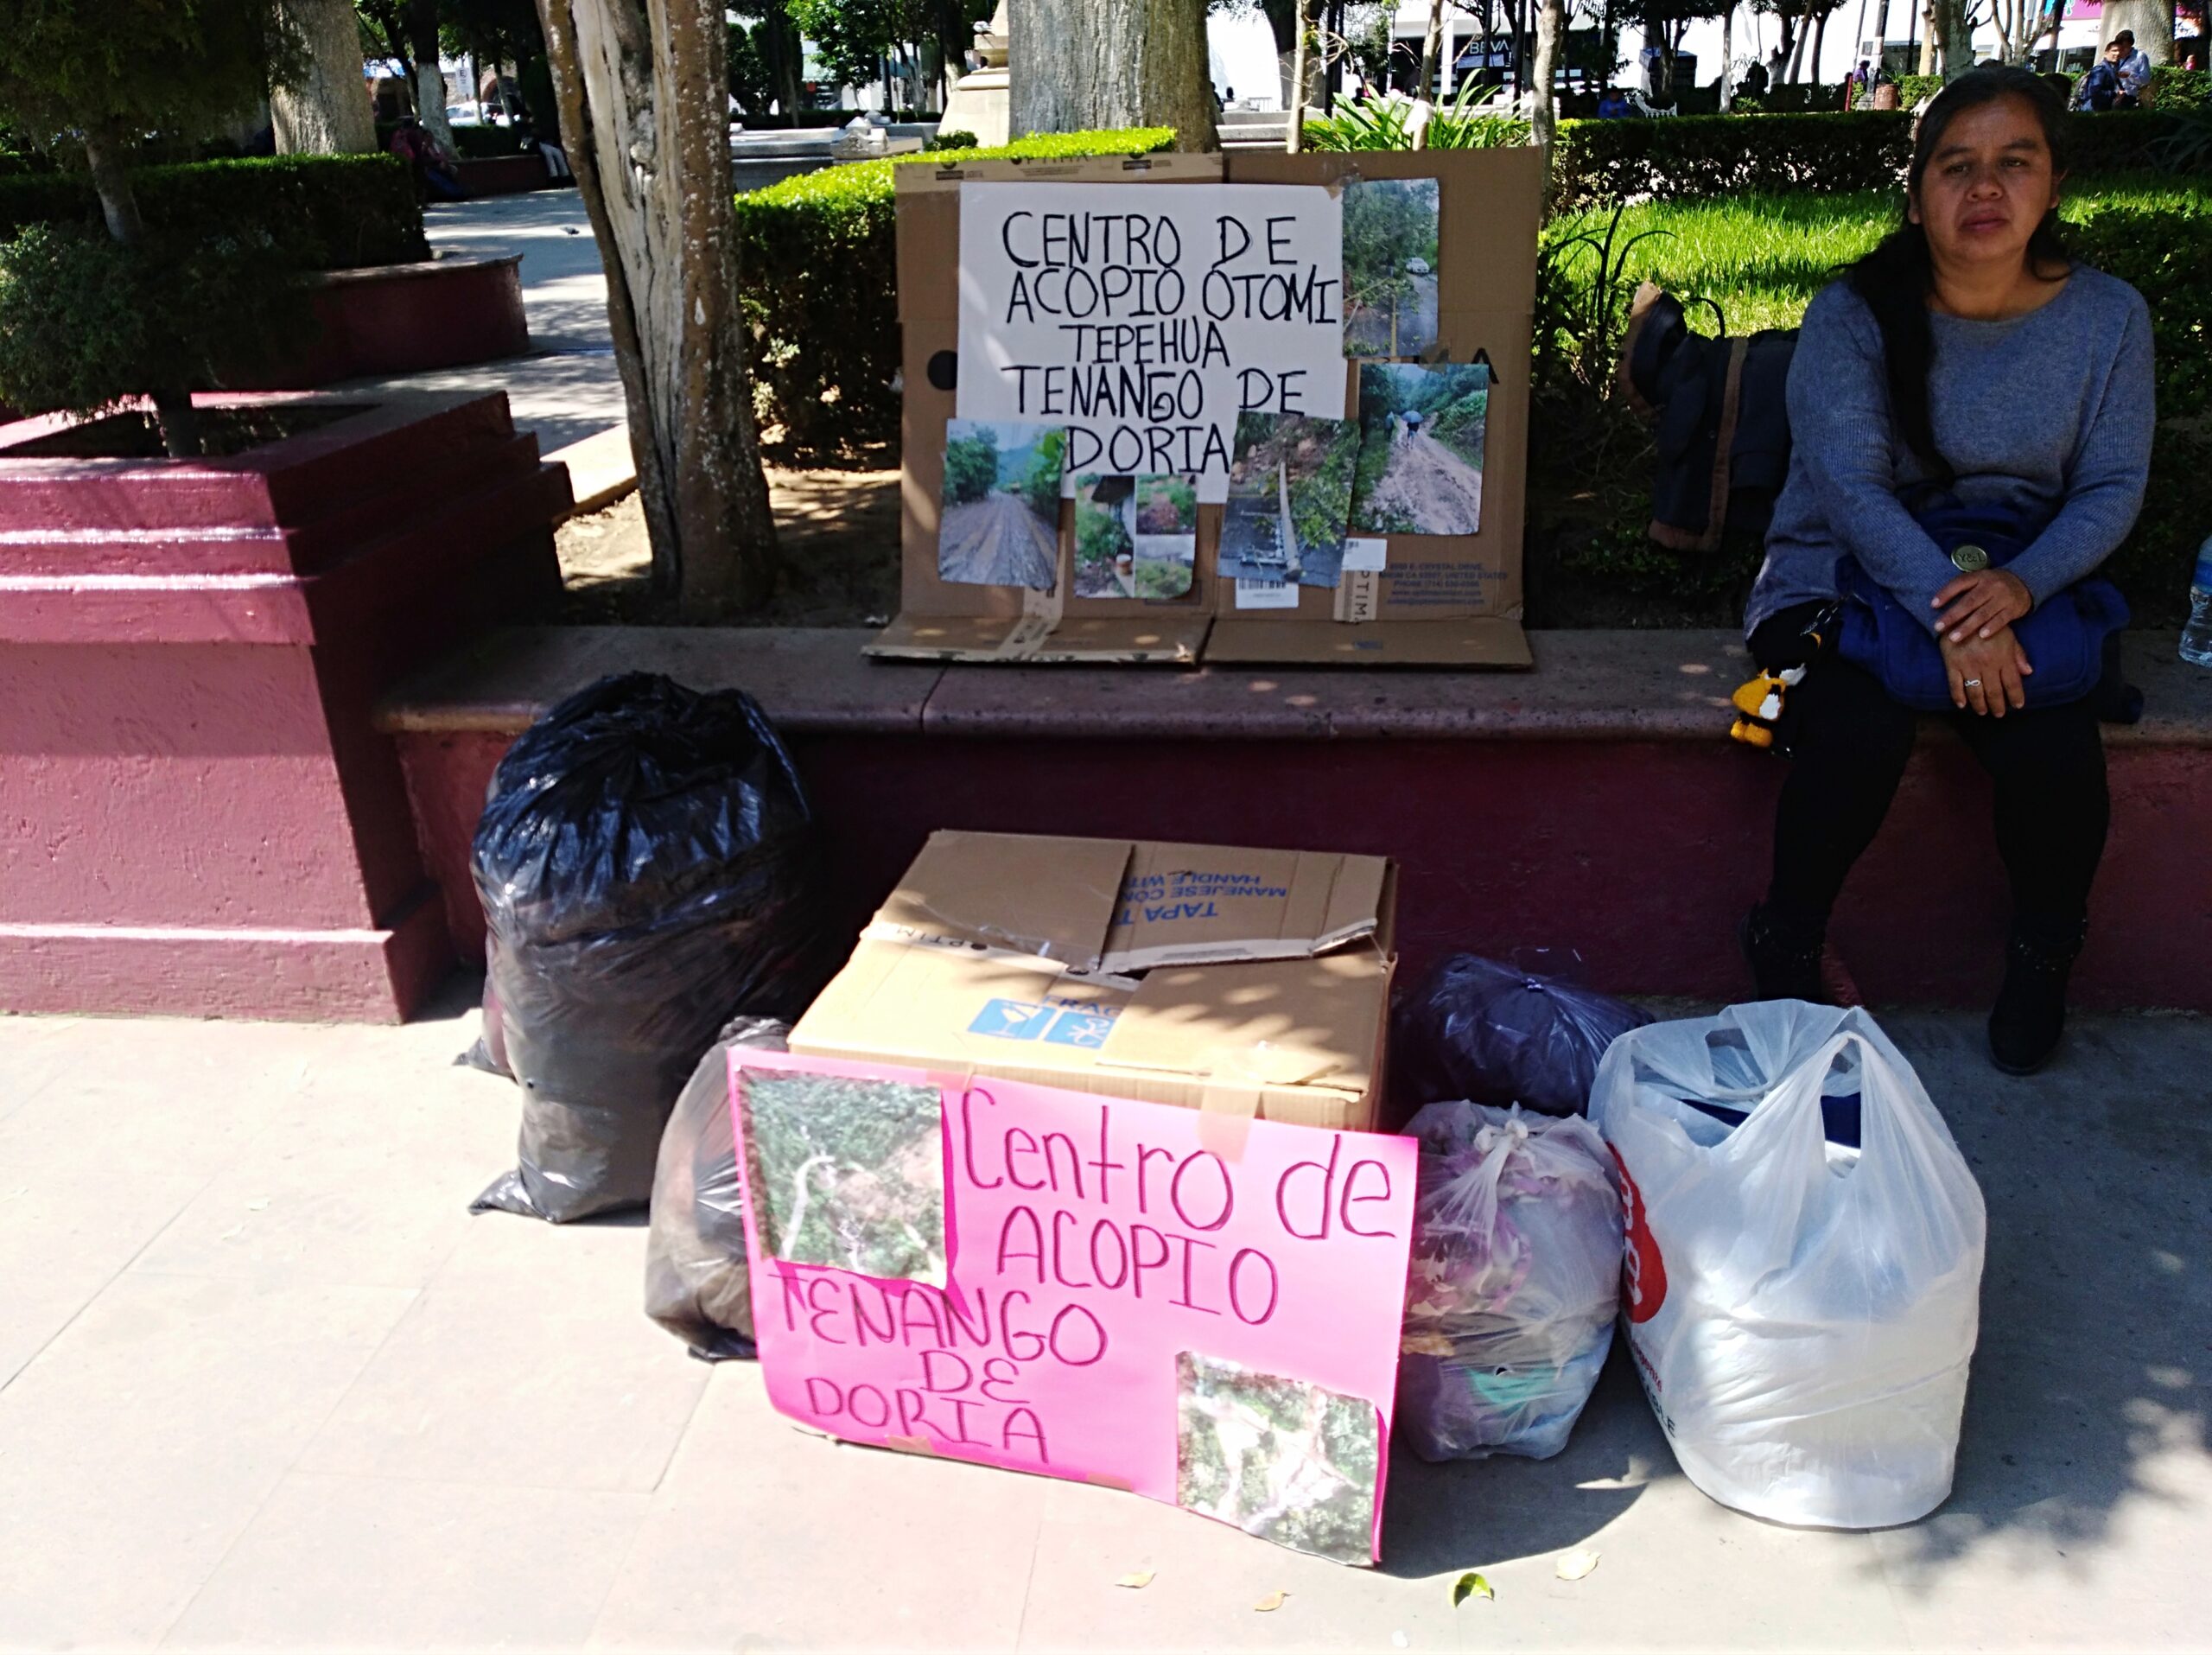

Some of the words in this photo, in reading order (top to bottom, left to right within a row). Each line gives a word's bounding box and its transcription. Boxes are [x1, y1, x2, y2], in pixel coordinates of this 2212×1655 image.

[1003, 211, 1181, 268] CENTRO
[1211, 215, 1298, 269] DE
[1007, 264, 1185, 324] ACOPIO
[1202, 264, 1339, 324] OTOMI
[1058, 315, 1230, 369] TEPEHUA
[1001, 364, 1205, 423] TENANGO
[1236, 367, 1307, 417] DE
[1065, 423, 1230, 475] DORIA
[1145, 901, 1218, 923] TAPA
[1171, 884, 1287, 899] MANEJESE
[962, 1087, 1234, 1232] Centro
[1276, 1133, 1398, 1239] de
[997, 1205, 1279, 1326] ACOPIO
[767, 1273, 1108, 1367] TENANGO
[919, 1349, 1031, 1404] DE
[804, 1377, 1050, 1464] DORIA
